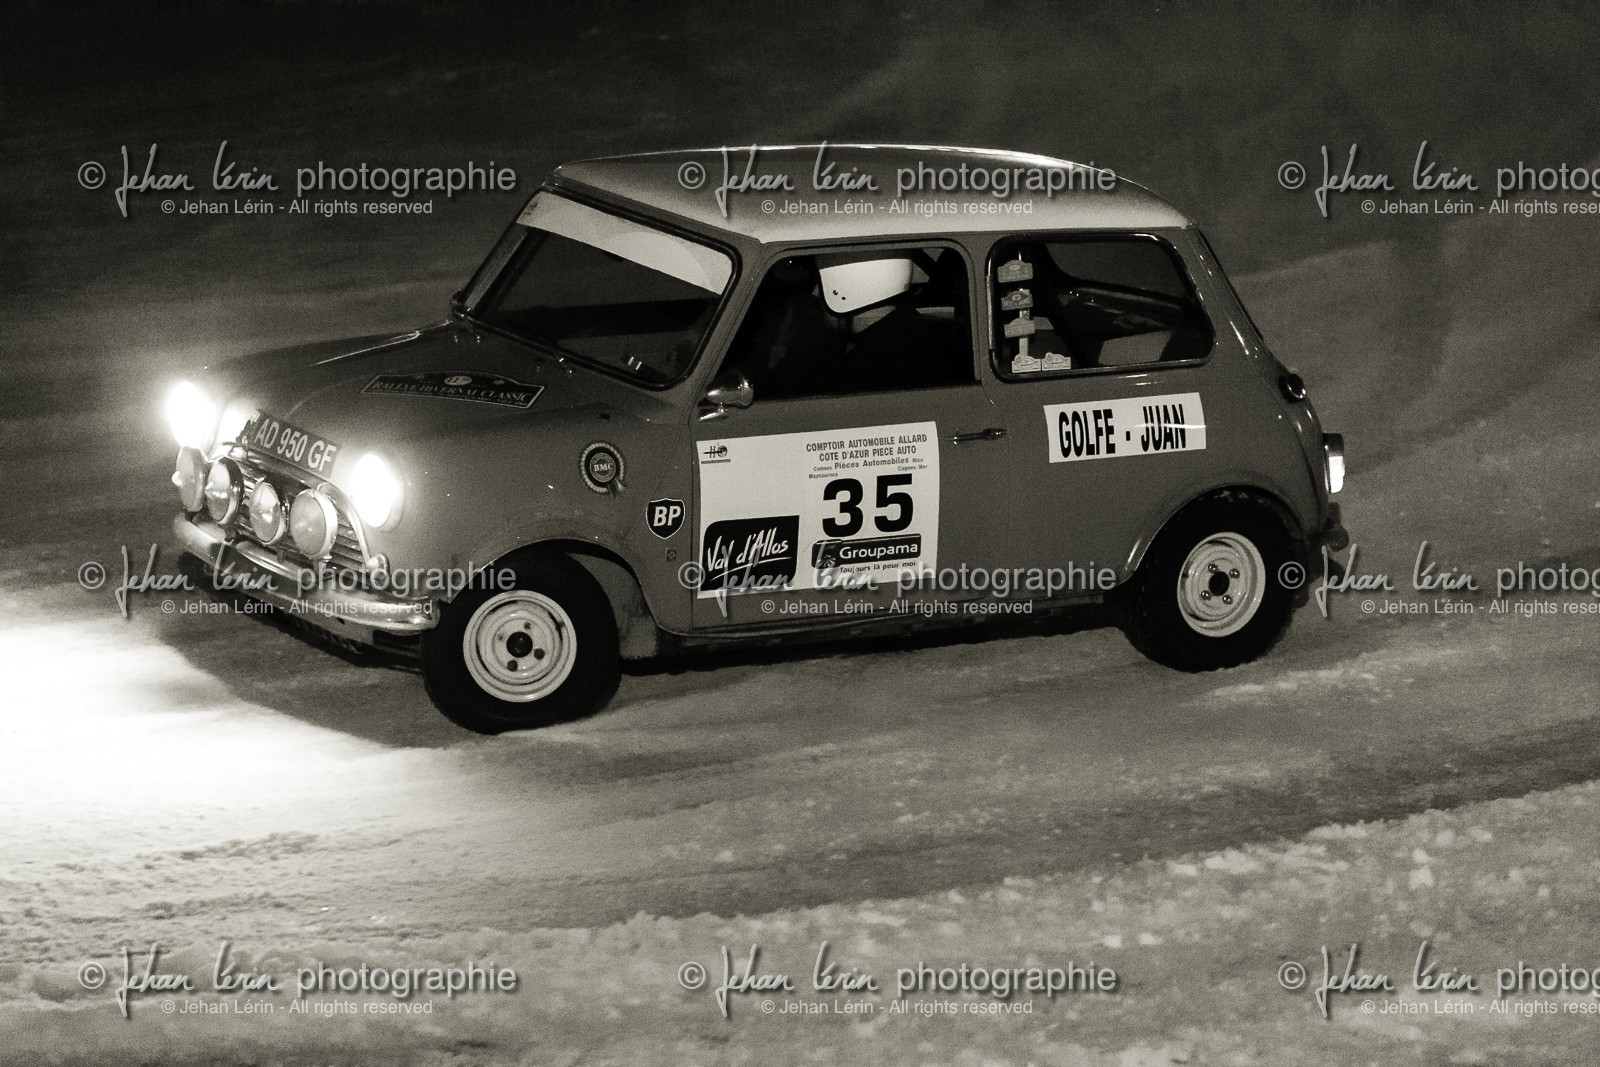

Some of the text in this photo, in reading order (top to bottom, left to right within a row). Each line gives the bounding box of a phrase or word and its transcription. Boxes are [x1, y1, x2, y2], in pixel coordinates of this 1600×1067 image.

[1058, 408, 1116, 459] GOLFE
[1141, 403, 1187, 453] JUAN
[254, 419, 337, 472] AD 950 GF
[806, 433, 927, 452] COMPTOIR AUTOMOBILE ALLARD
[819, 445, 917, 462] COTE D'AZUR PIECE AUTO
[862, 457, 909, 467] Automobiles
[593, 462, 614, 472] BMC
[822, 473, 914, 537] 35
[653, 505, 681, 528] BP
[707, 527, 789, 572] Val d'Allos
[839, 543, 919, 560] Groupama
[882, 562, 899, 572] pour
